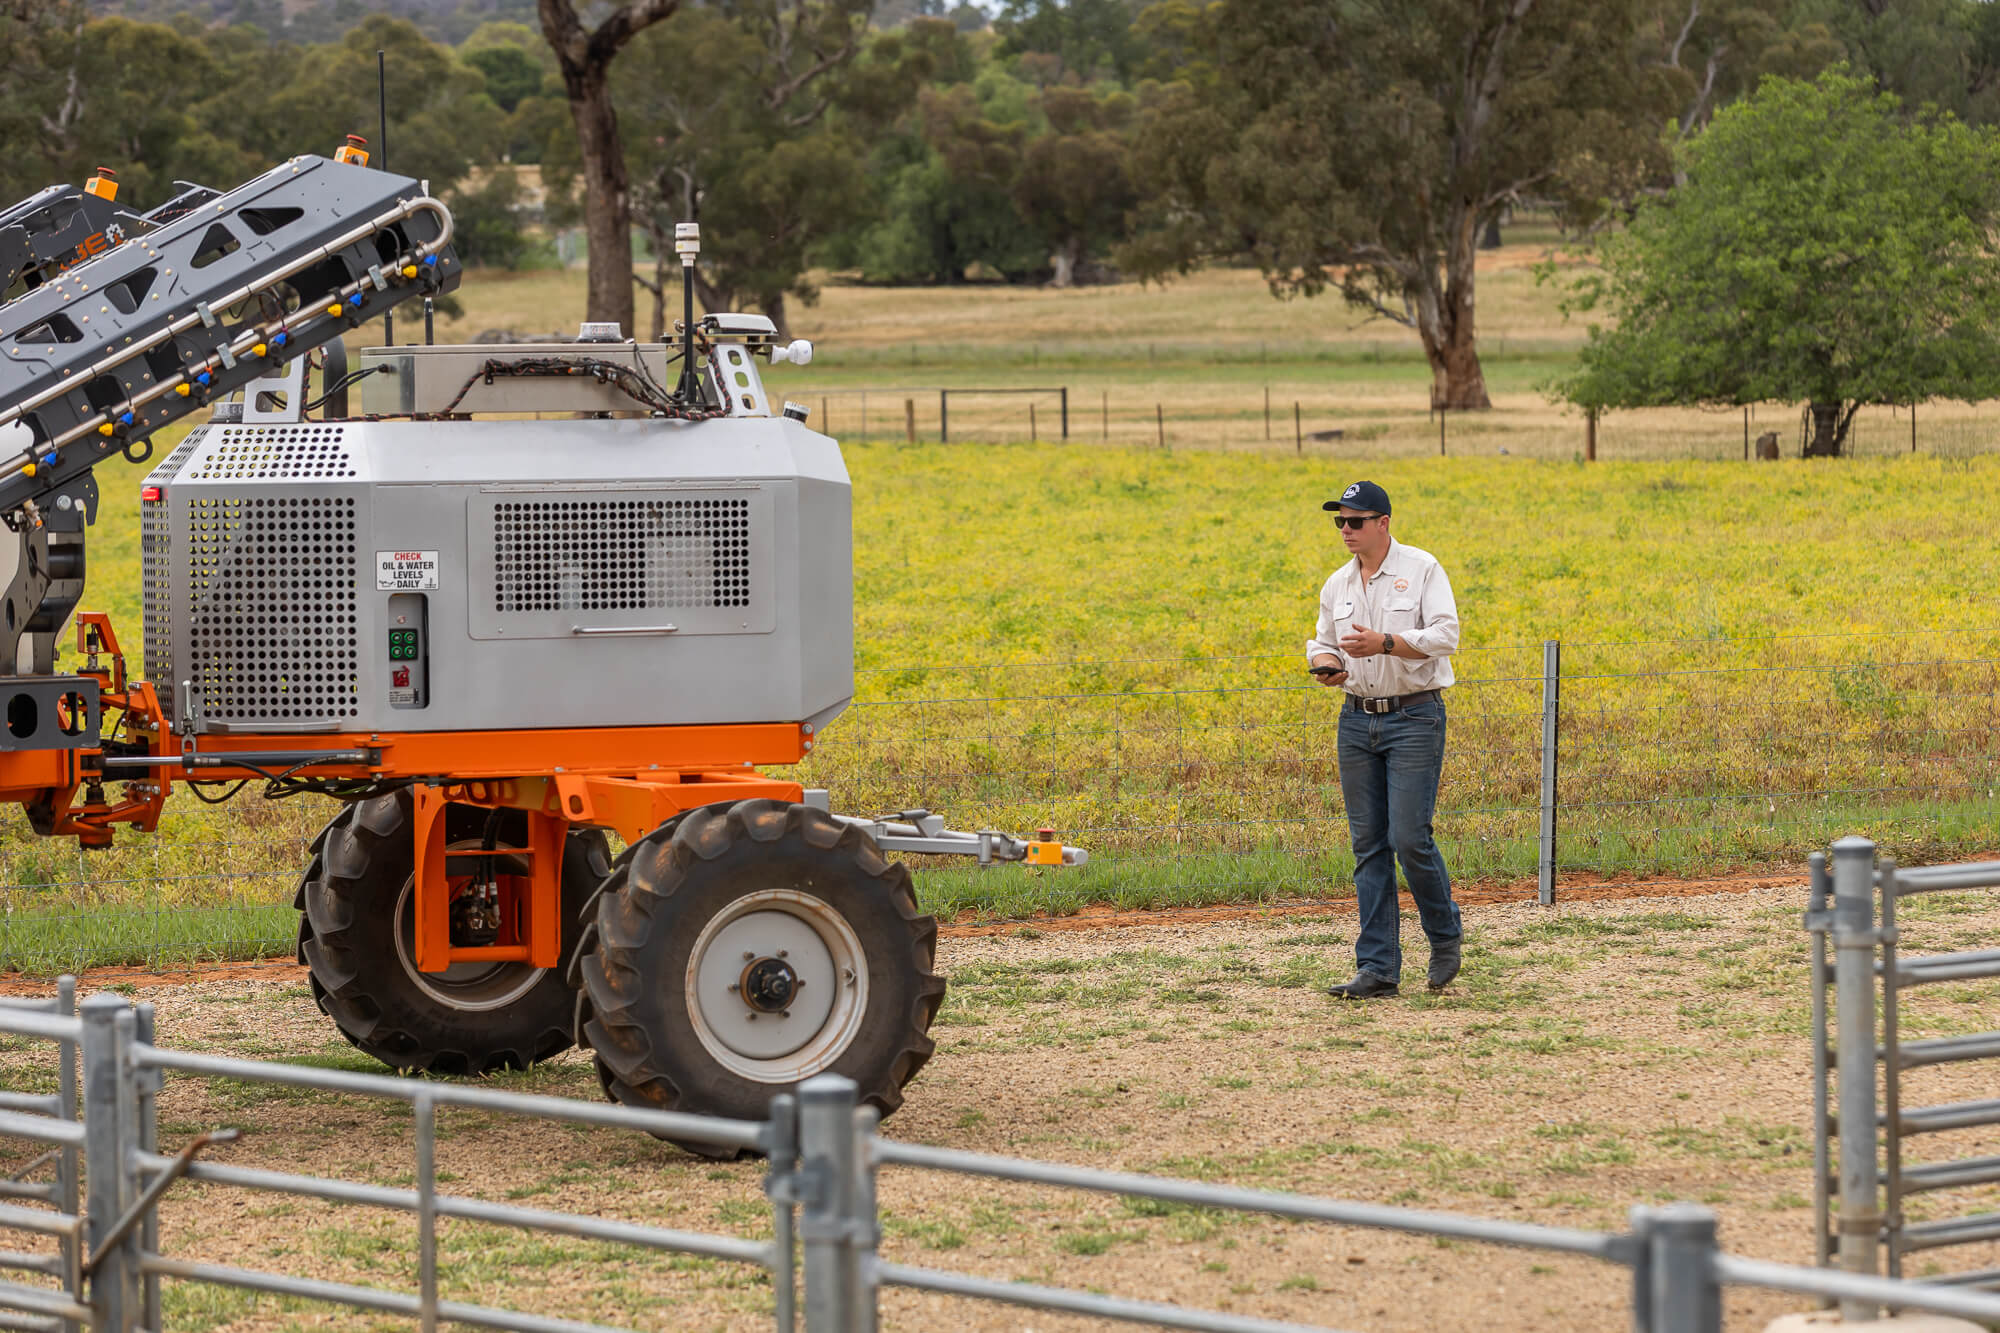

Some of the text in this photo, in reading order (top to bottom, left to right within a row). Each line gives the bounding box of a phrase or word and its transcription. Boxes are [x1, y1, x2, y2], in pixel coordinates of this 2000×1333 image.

[394, 552, 422, 560] CHECK
[382, 561, 434, 570] OIL & WATER
[393, 571, 423, 579] LEVELS
[397, 580, 420, 588] DAILY
